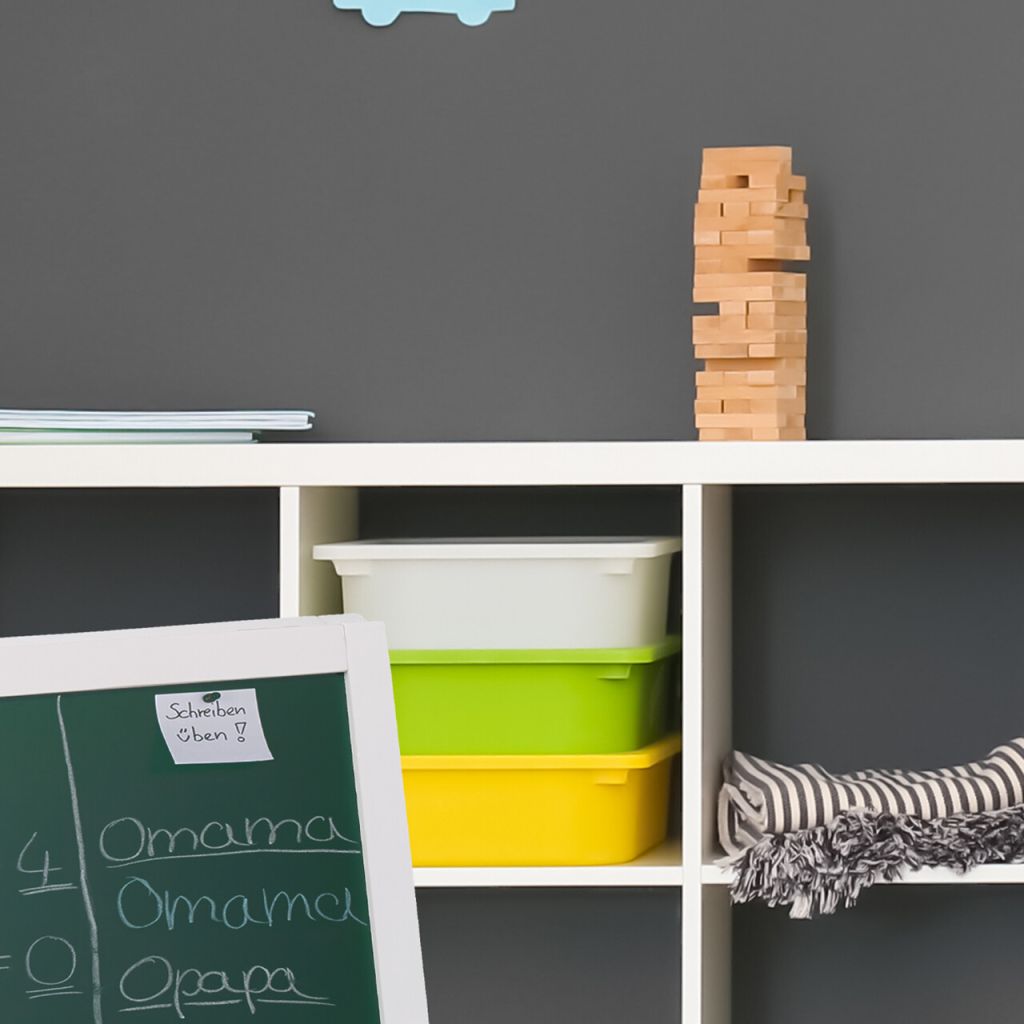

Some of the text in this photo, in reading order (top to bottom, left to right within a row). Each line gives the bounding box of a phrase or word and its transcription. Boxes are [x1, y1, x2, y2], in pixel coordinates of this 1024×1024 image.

[166, 701, 246, 720] Schreiben
[99, 813, 360, 862] Omama
[116, 876, 367, 931] Omama
[119, 955, 333, 1020] Opapa
